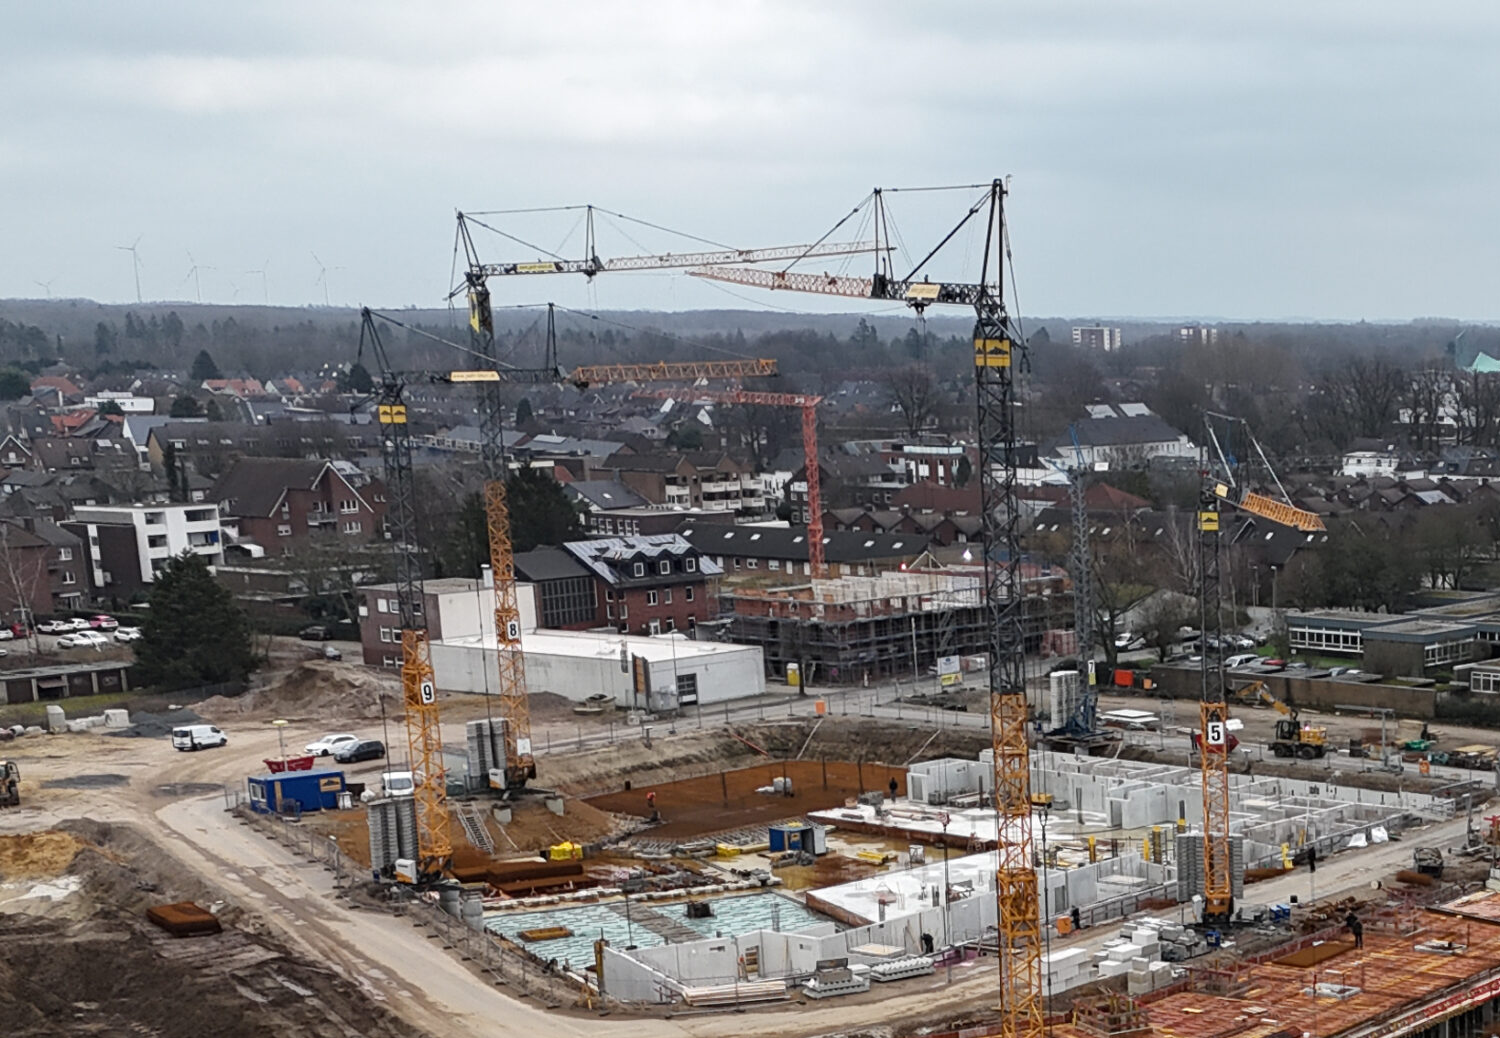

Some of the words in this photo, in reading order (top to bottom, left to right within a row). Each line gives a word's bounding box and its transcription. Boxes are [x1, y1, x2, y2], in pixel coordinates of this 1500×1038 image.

[509, 623, 517, 637] 8
[1089, 662, 1094, 673] 7
[423, 684, 433, 701] 9
[1211, 724, 1221, 742] 5
